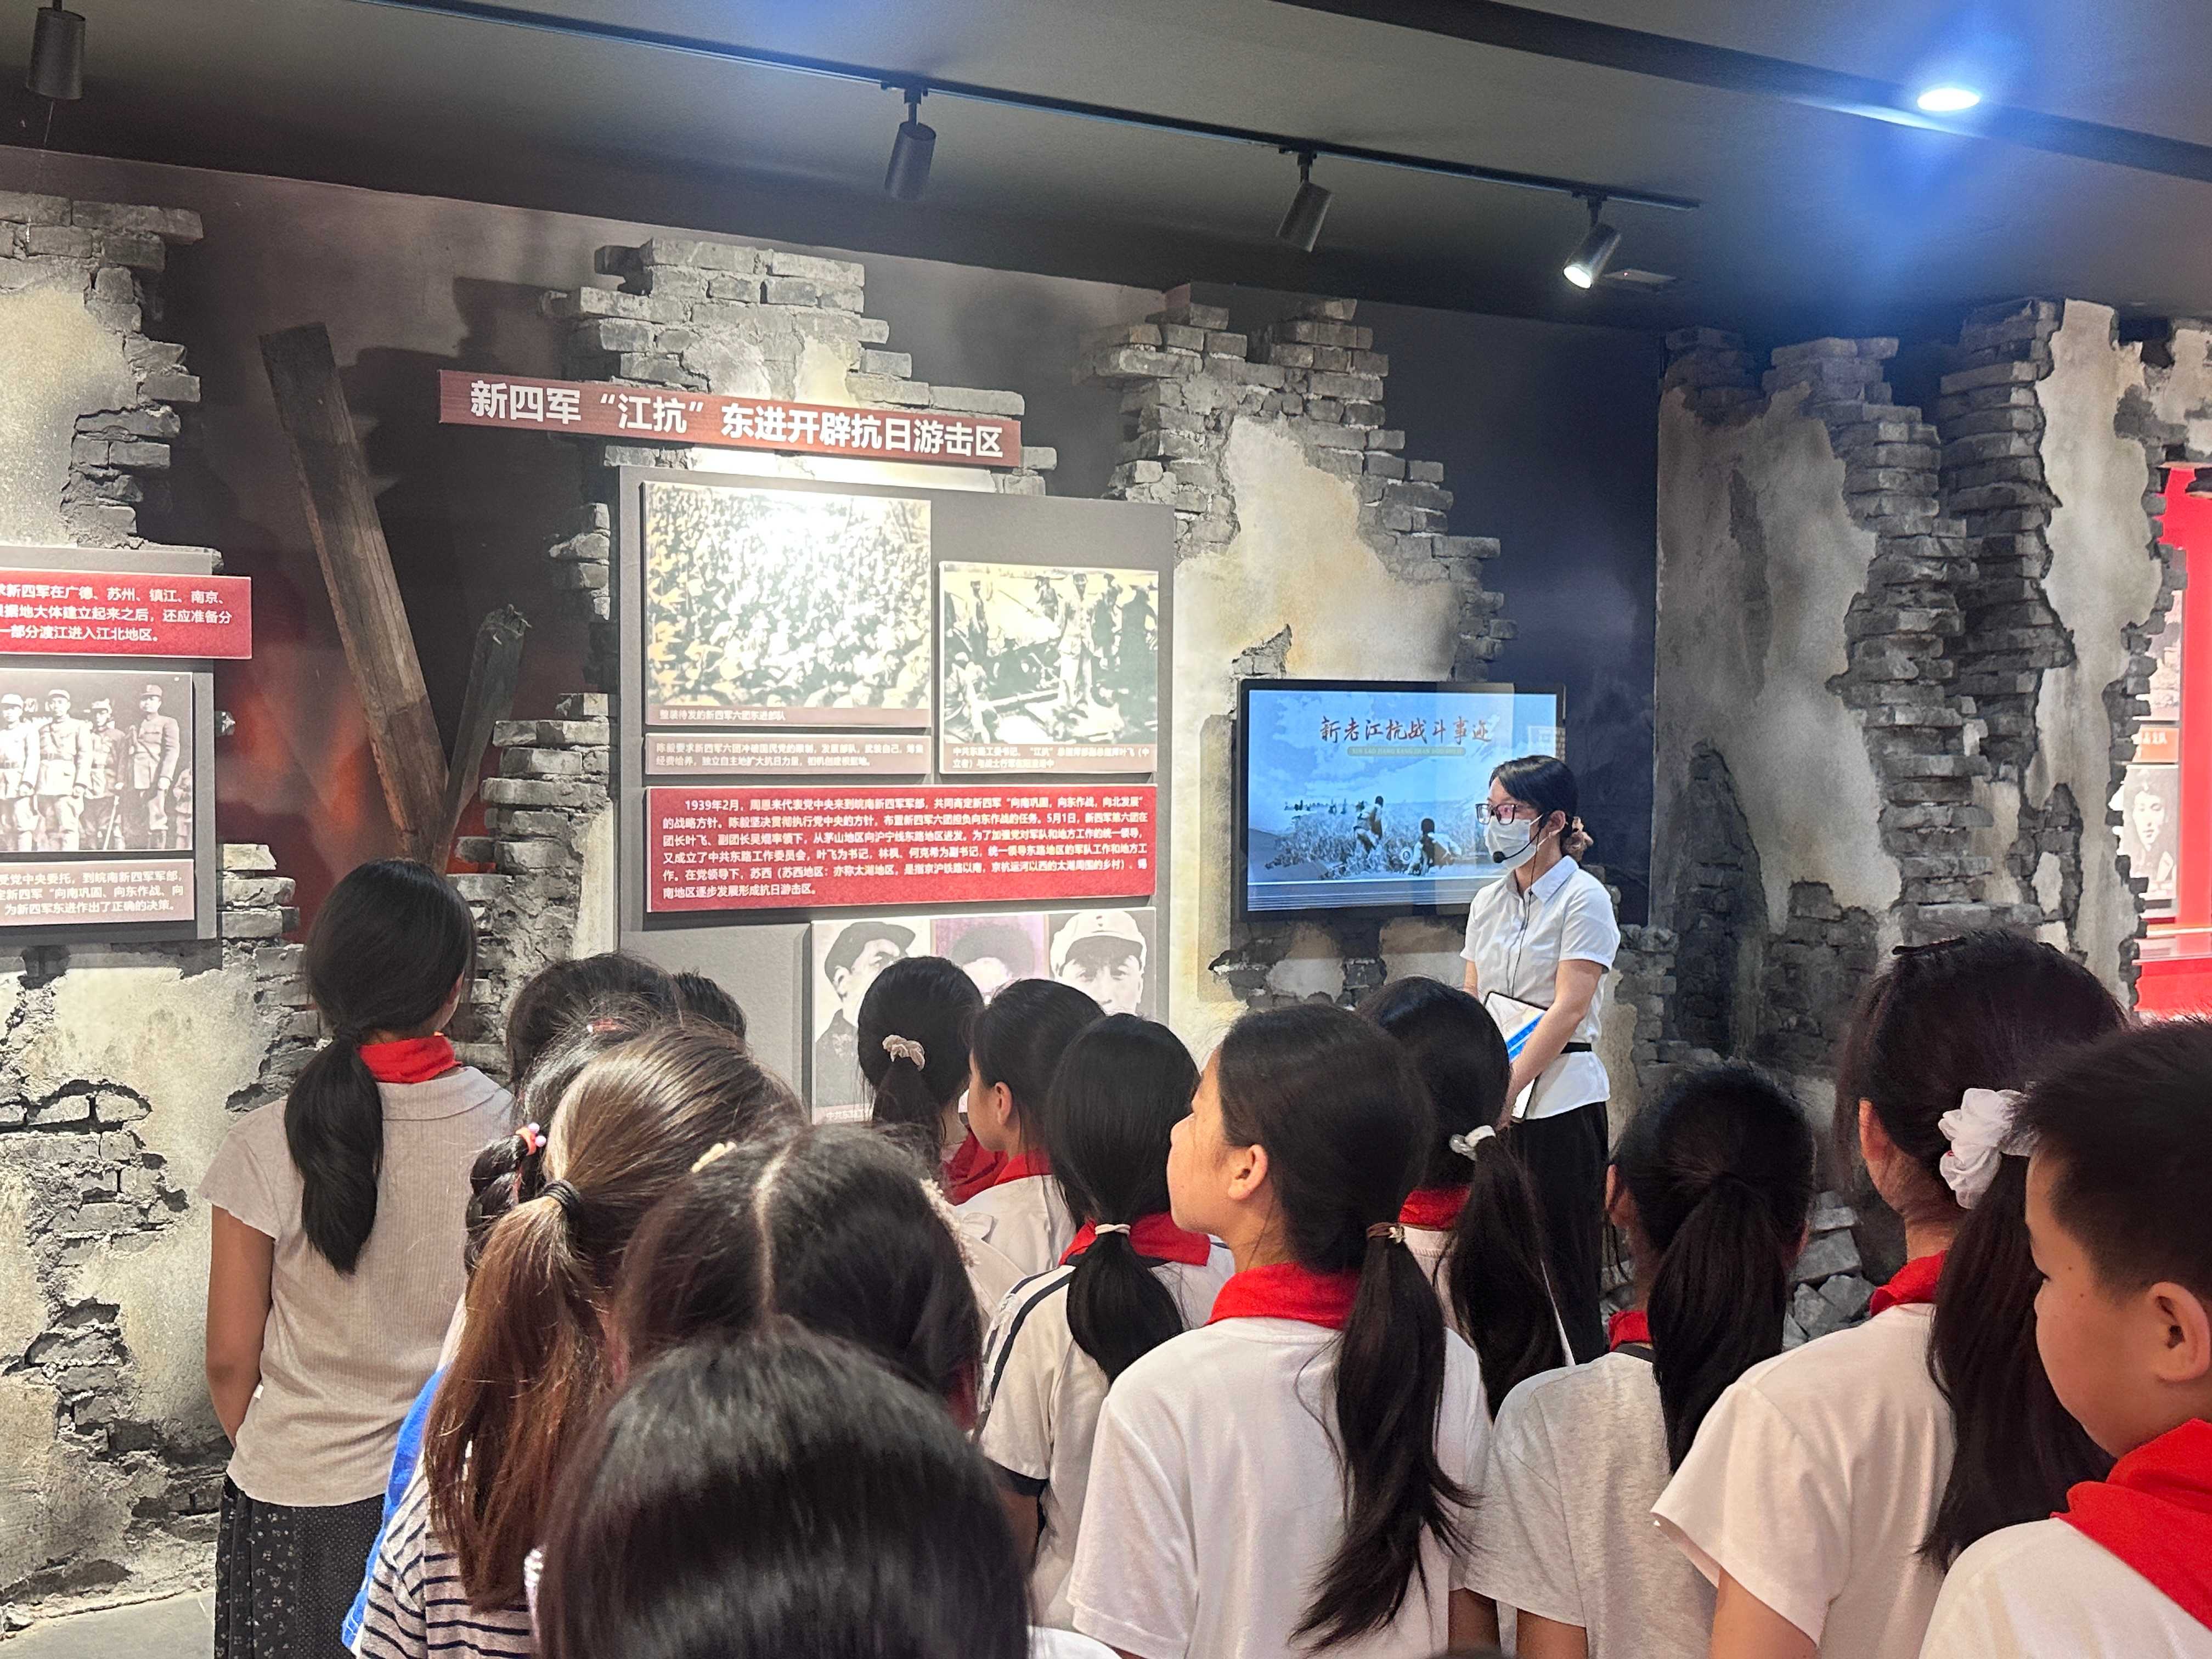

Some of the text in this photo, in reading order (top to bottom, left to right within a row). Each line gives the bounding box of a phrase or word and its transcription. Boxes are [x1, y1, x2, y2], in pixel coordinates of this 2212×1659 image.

[0, 605, 233, 624] 据地大体建立起来之后，还应准备分
[1320, 715, 1492, 744] 新老江抗战斗事迹
